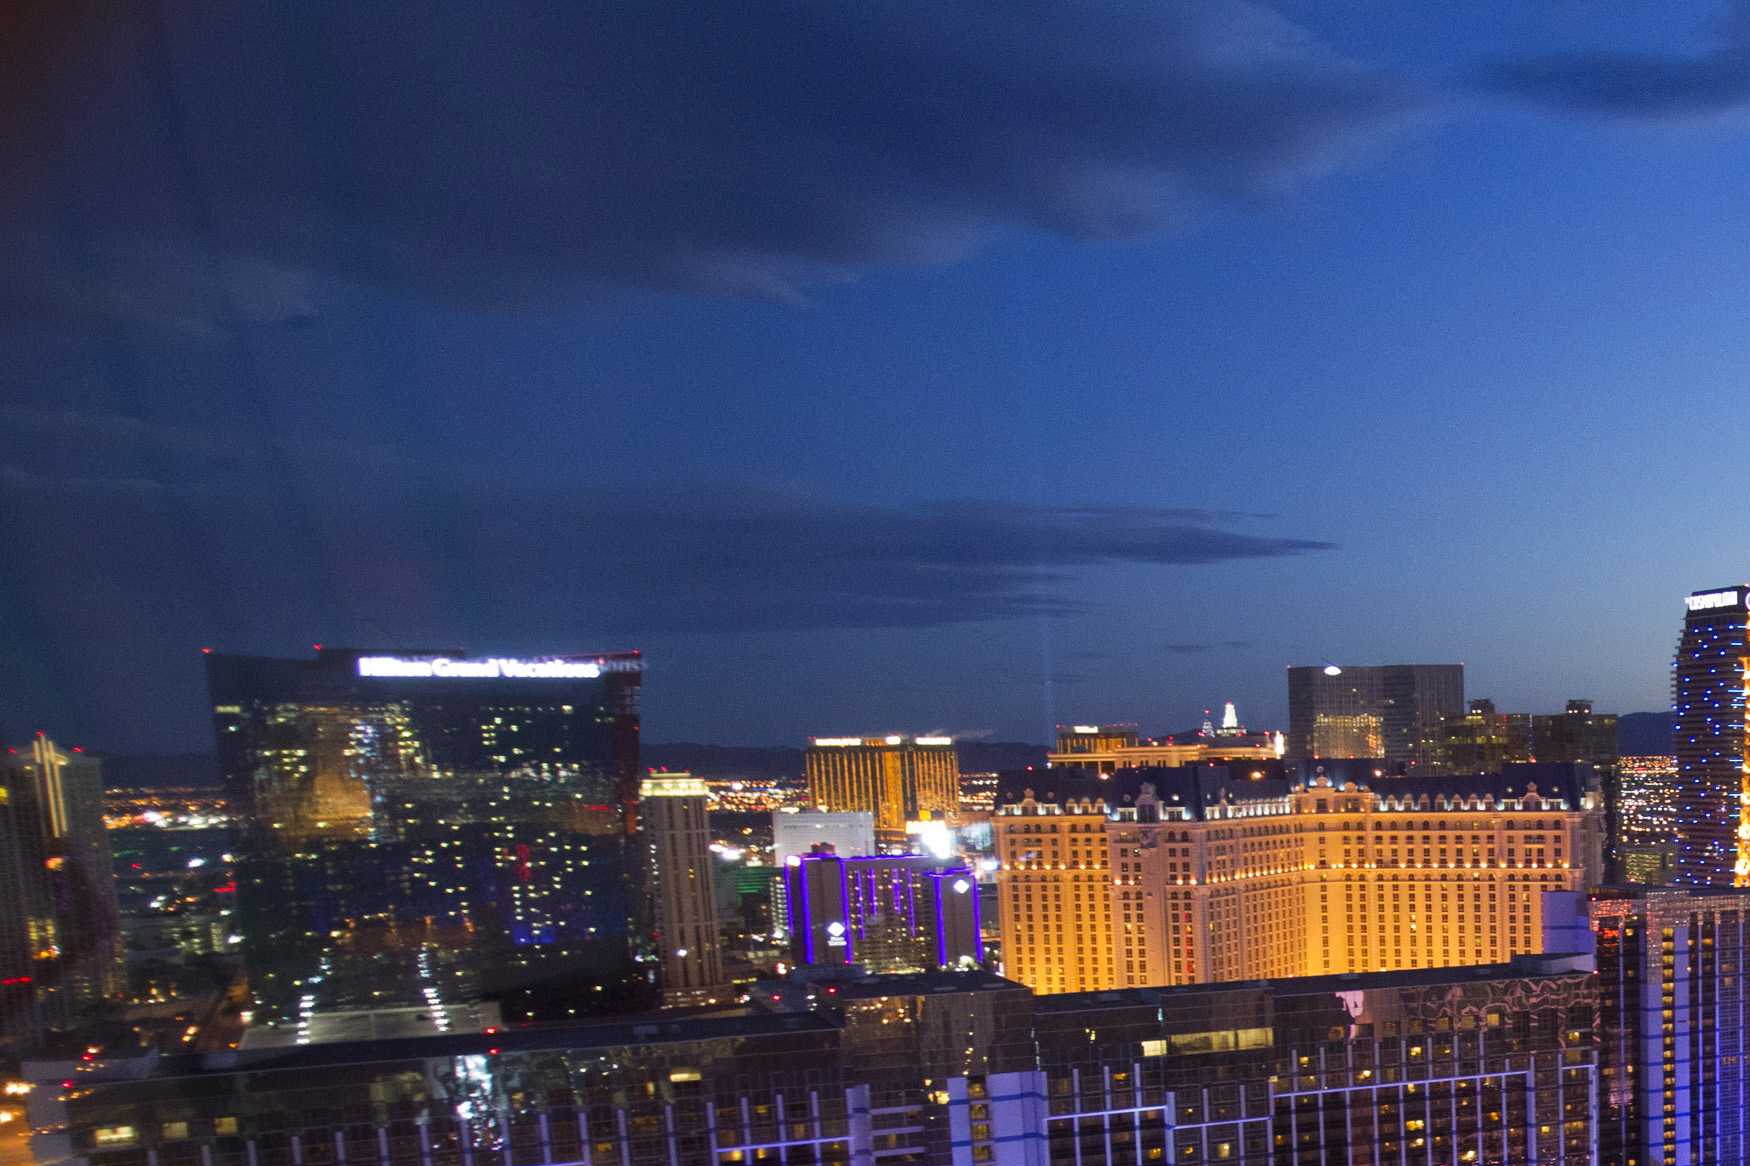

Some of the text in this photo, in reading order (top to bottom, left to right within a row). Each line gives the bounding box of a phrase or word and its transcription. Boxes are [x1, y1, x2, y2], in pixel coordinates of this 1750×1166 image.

[359, 657, 431, 677] Hilton
[432, 658, 499, 678] Grand
[499, 658, 600, 678] Vacations
